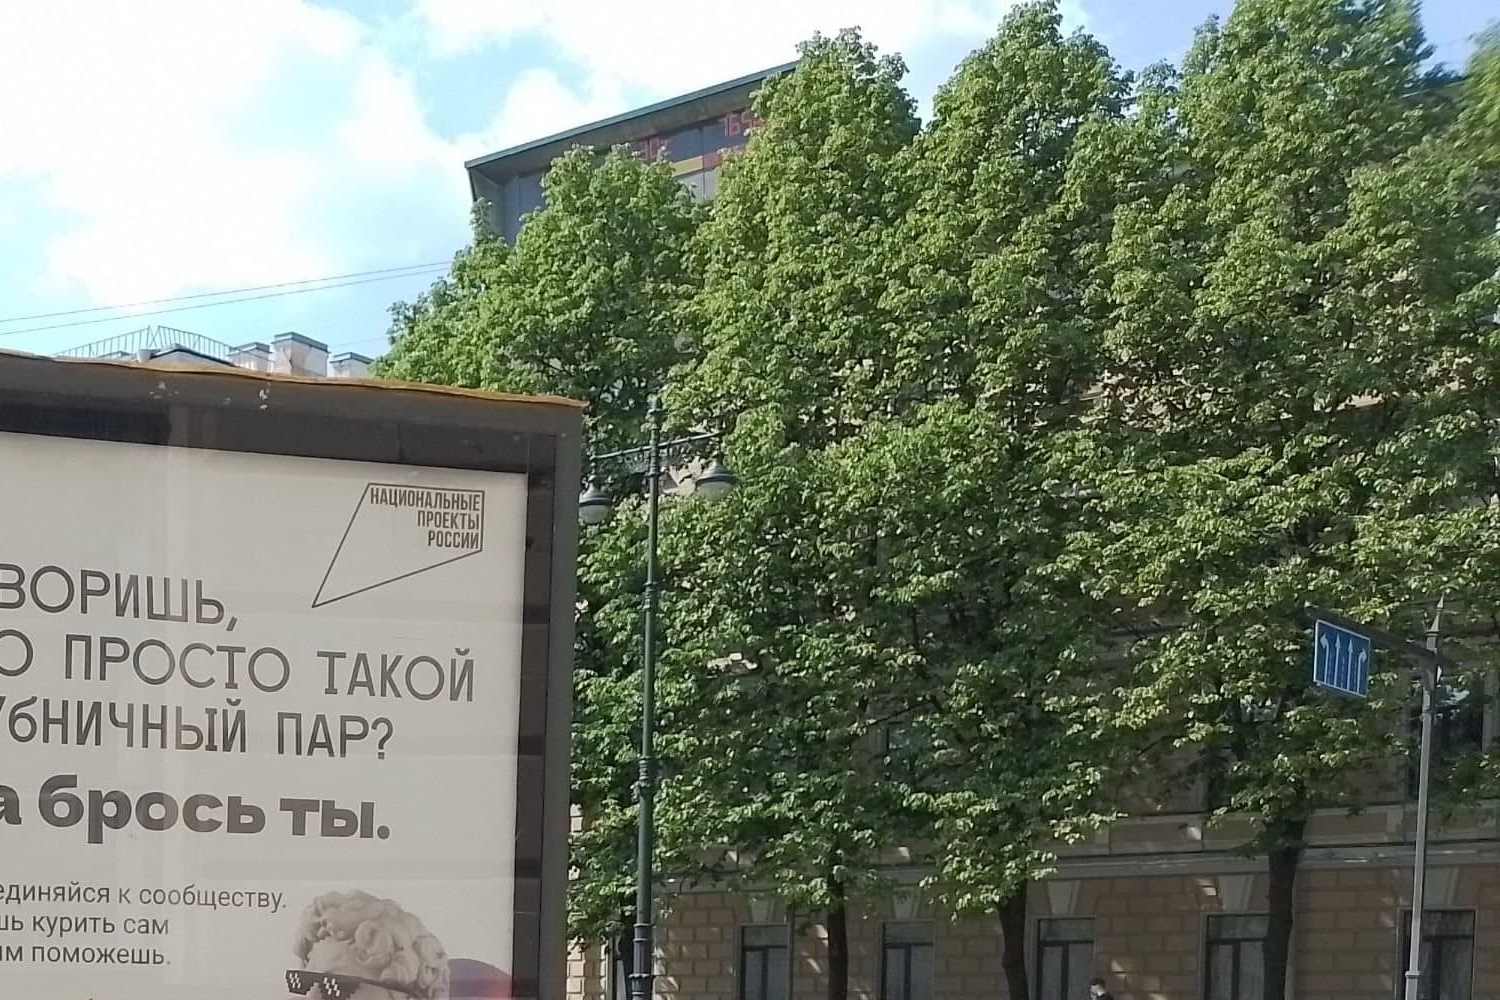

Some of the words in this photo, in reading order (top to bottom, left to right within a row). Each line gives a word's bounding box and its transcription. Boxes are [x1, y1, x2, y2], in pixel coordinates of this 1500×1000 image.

[371, 488, 480, 511] НАЦИОНАЛЬНЫЕ
[416, 510, 480, 530] ПРОЕКТЫ
[427, 530, 479, 549] РОССИИ
[64, 633, 291, 693] ПРОСТО
[316, 647, 475, 703] ТАКОЙ
[277, 711, 395, 761] ПАР?
[37, 773, 266, 845] брось
[279, 797, 391, 840] ты.
[118, 888, 131, 904] к
[139, 883, 287, 914] сообществу.
[32, 916, 116, 939] курить
[123, 919, 169, 936] сам
[31, 945, 172, 967] поможешь.
